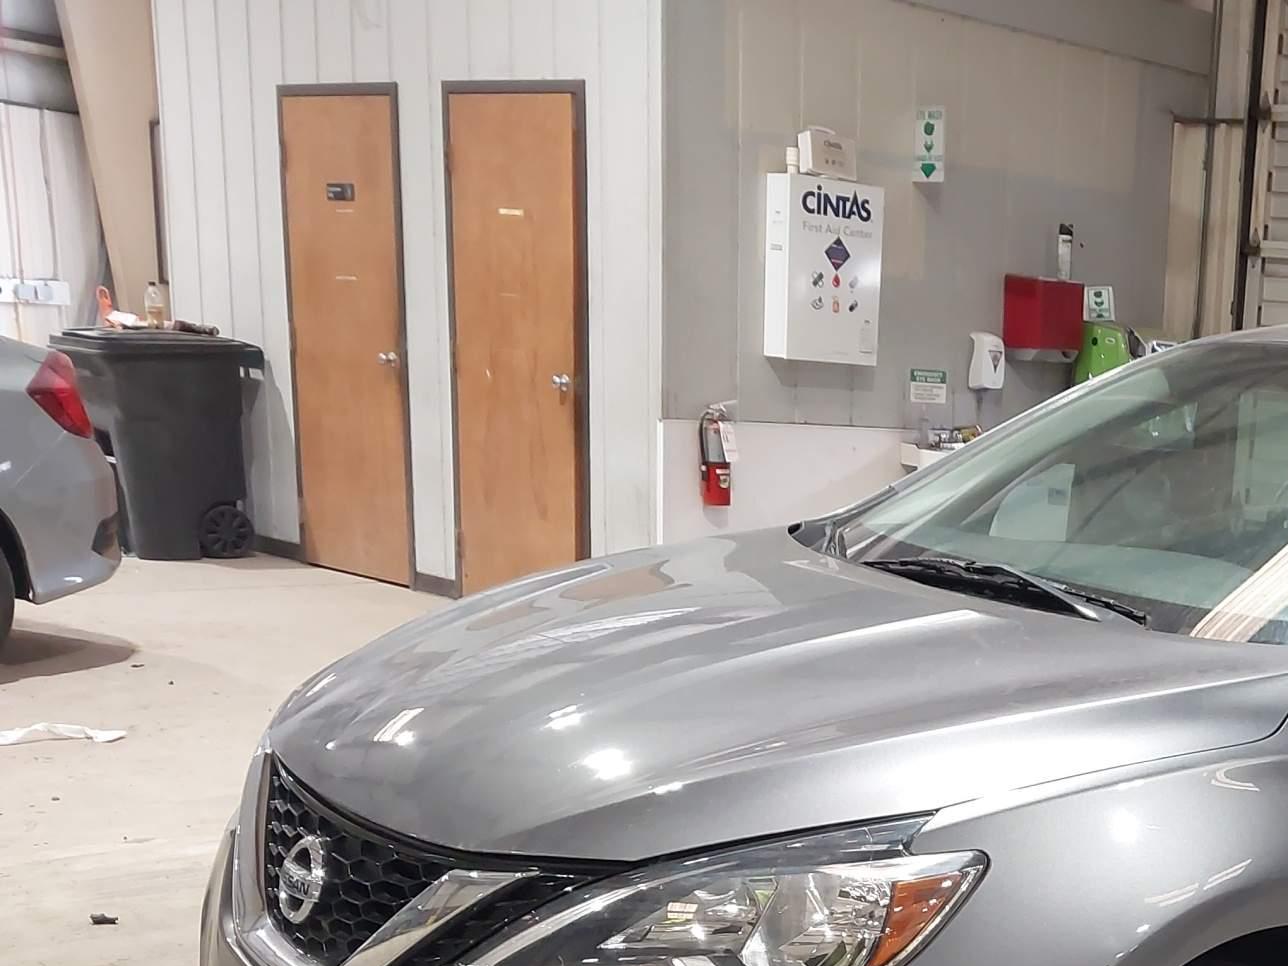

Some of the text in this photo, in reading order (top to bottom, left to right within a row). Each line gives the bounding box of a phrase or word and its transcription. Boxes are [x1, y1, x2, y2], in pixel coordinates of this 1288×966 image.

[802, 220, 873, 239] First Aid Center
